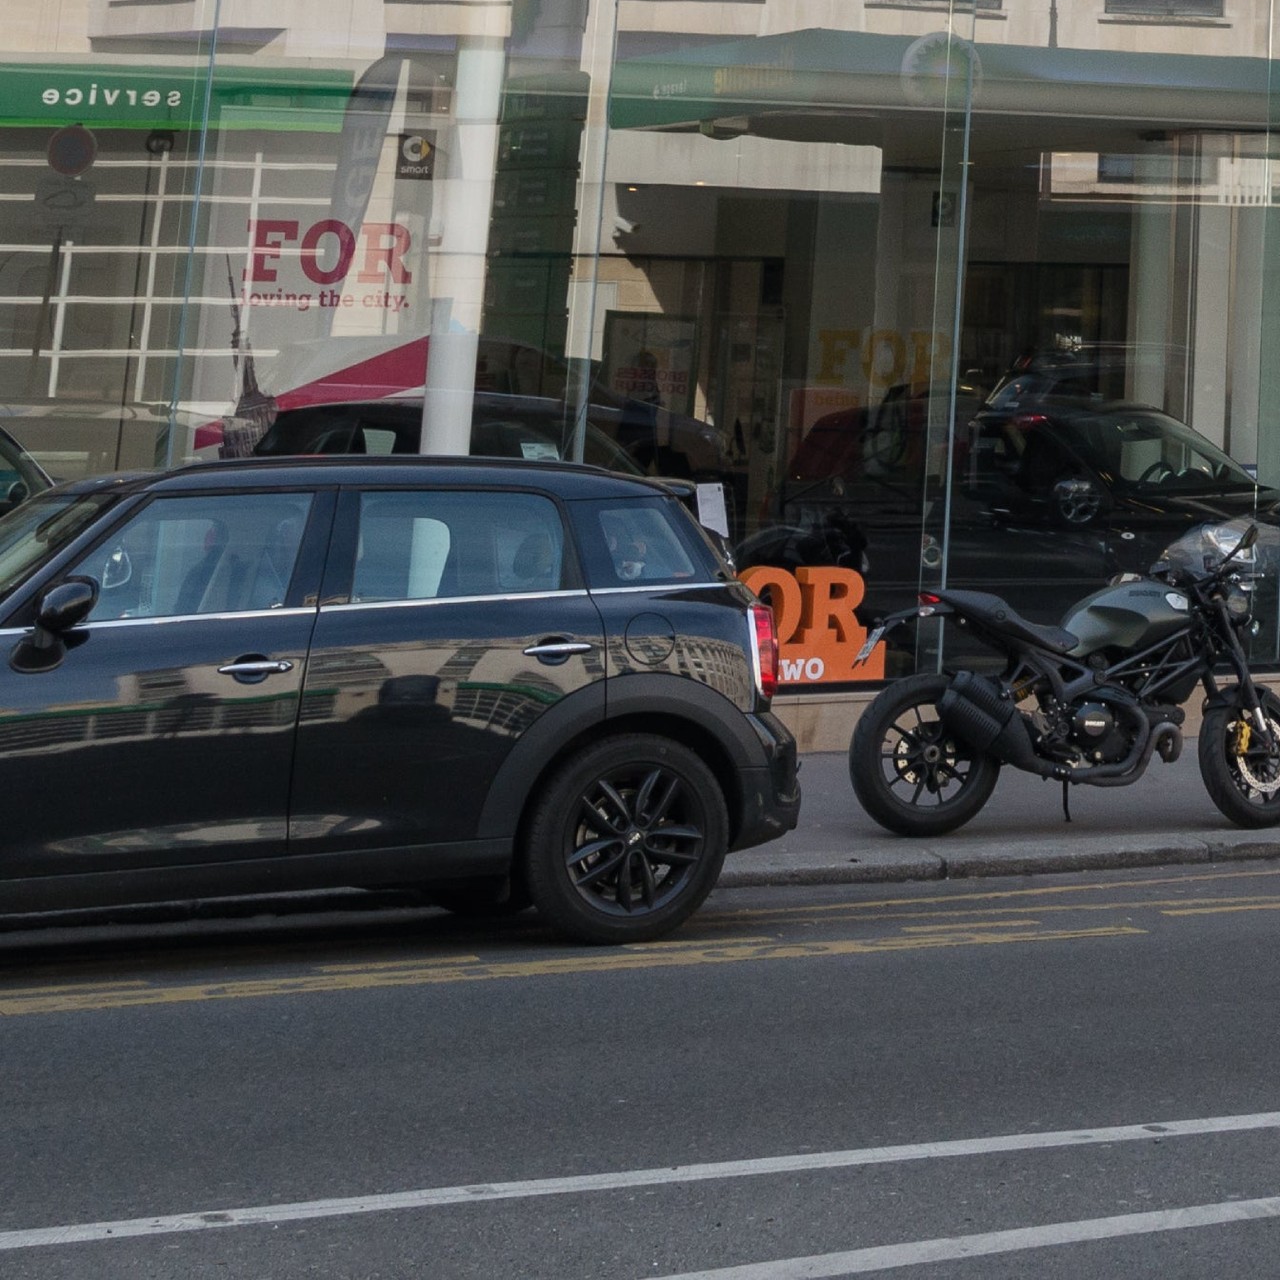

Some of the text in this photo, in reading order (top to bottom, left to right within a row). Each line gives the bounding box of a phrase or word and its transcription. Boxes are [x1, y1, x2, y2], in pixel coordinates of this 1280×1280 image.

[401, 165, 428, 175] smart
[242, 218, 412, 285] FOR
[240, 288, 410, 312] loving the city.
[778, 657, 825, 681] WO
